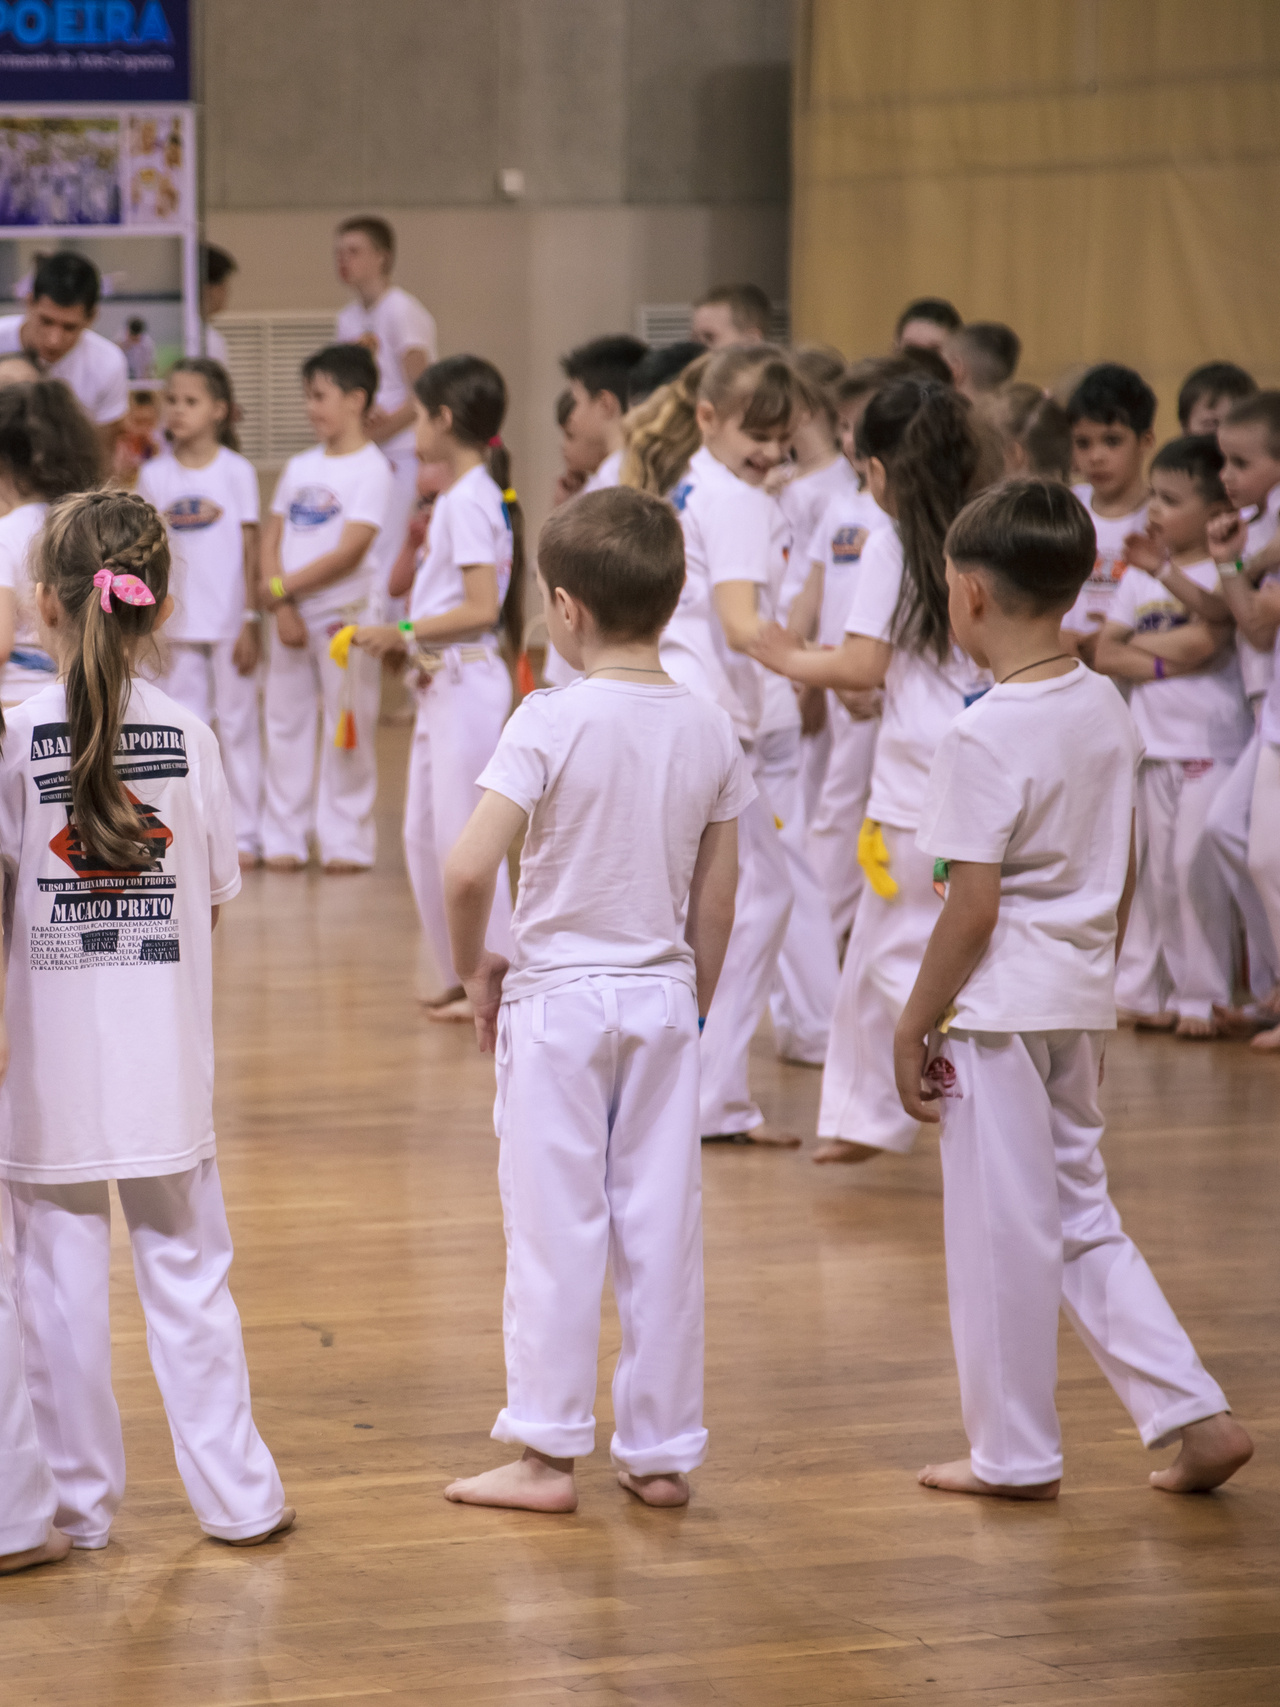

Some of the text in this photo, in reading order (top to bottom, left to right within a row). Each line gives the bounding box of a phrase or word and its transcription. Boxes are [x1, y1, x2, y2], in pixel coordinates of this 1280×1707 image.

[38, 883, 64, 892] CURSO
[65, 882, 75, 891] DE
[77, 878, 125, 890] TREINAMENTO
[126, 877, 142, 886] COM
[53, 897, 172, 923] MACACO PRETO
